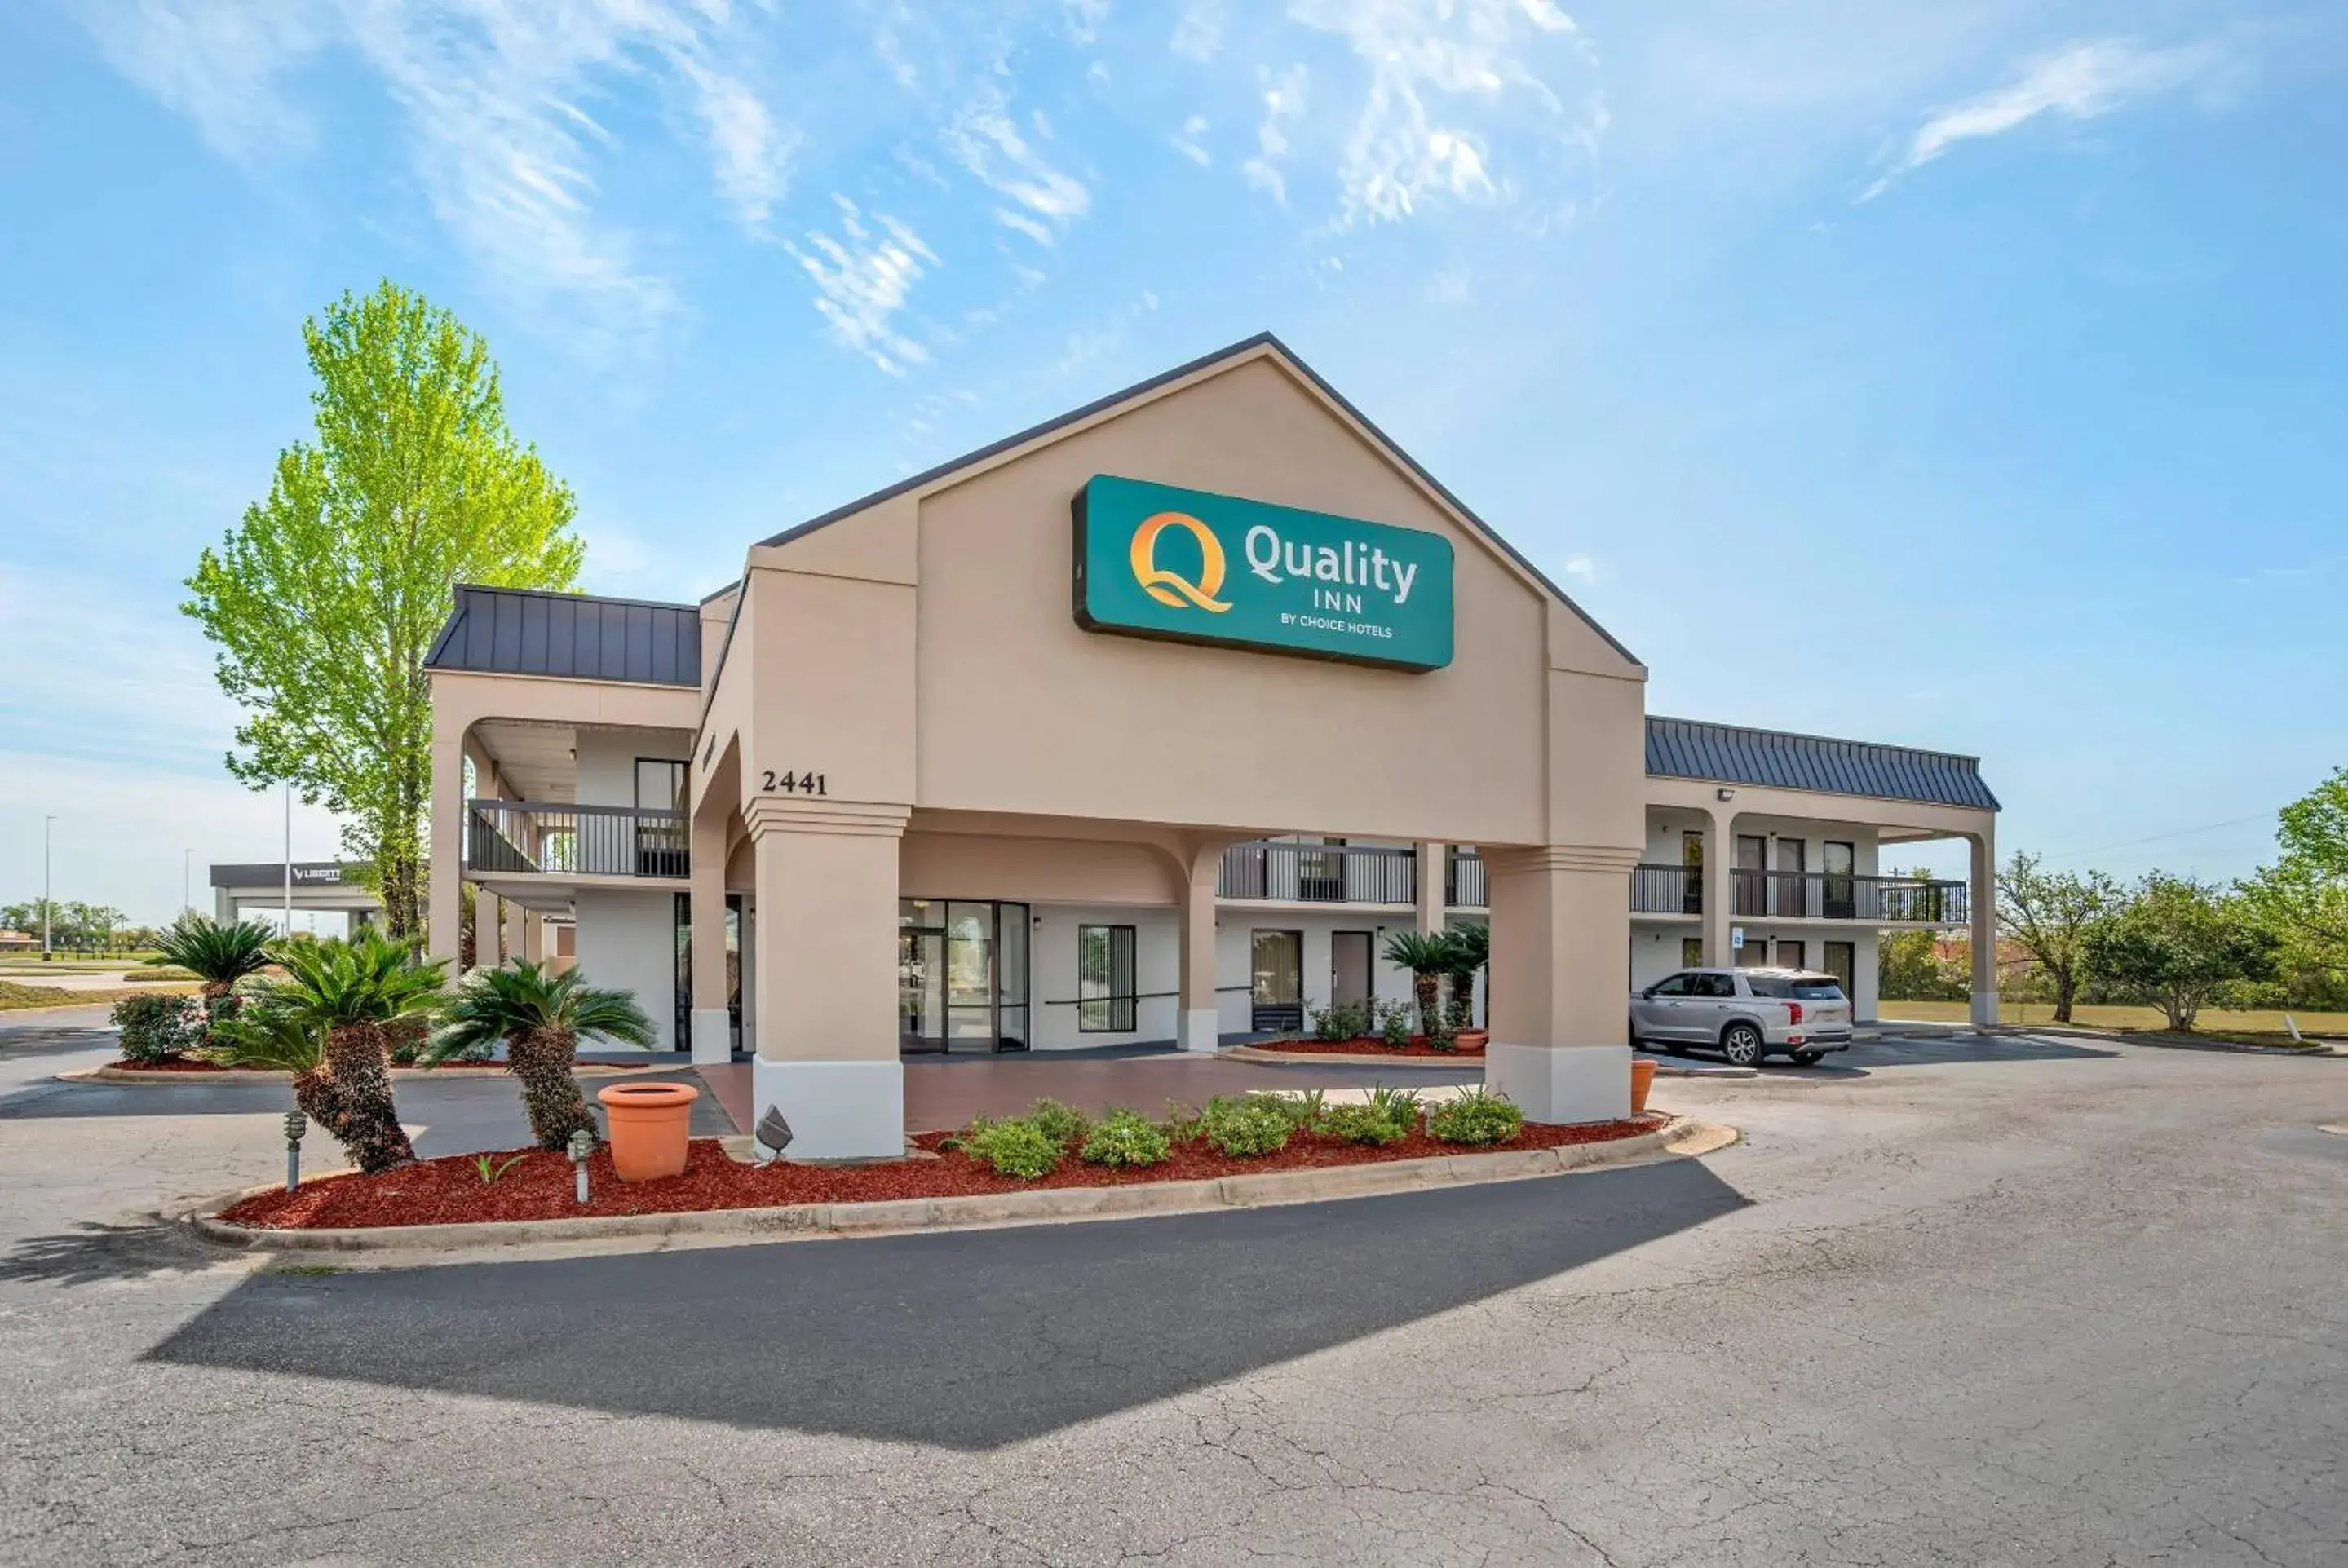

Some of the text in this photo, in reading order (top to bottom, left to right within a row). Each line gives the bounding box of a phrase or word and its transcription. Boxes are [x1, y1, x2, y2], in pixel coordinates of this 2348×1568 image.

[1245, 524, 1417, 604] Quality
[1314, 588, 1361, 614] INN
[1280, 612, 1393, 638] BY CHOICE HOTELS
[762, 770, 827, 796] 2441
